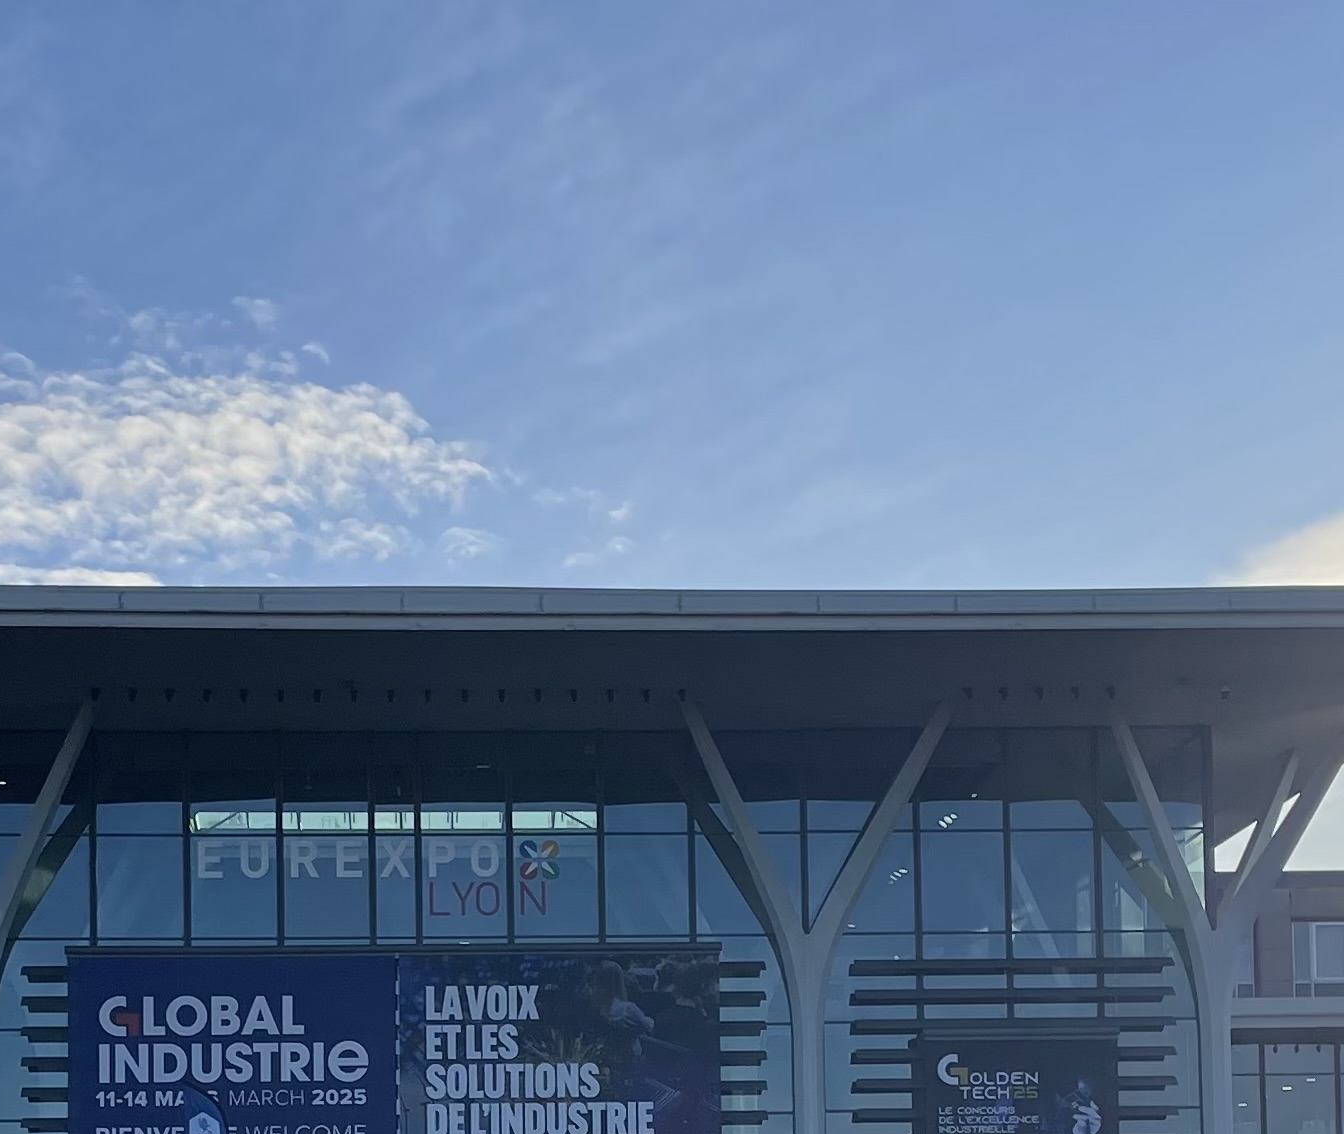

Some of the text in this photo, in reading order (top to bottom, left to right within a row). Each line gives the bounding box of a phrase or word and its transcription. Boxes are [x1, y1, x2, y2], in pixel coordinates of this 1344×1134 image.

[197, 839, 500, 879] EUREXPO
[429, 881, 547, 916] LYON
[98, 995, 305, 1037] GLOBAL
[425, 985, 539, 1021] LA VOIX
[425, 1024, 519, 1060] ET LES
[425, 1062, 601, 1100] SOLUTIONS
[937, 1053, 1039, 1086] GOLDEN
[95, 1091, 149, 1107] 11-14
[229, 1089, 305, 1106] MARCH
[311, 1088, 367, 1106] 2025
[959, 1086, 1010, 1100] TECH
[938, 1106, 1016, 1115] LE CONCOURS
[938, 1116, 955, 1125] DE
[938, 1125, 1016, 1134] INDUSTRIELLE
